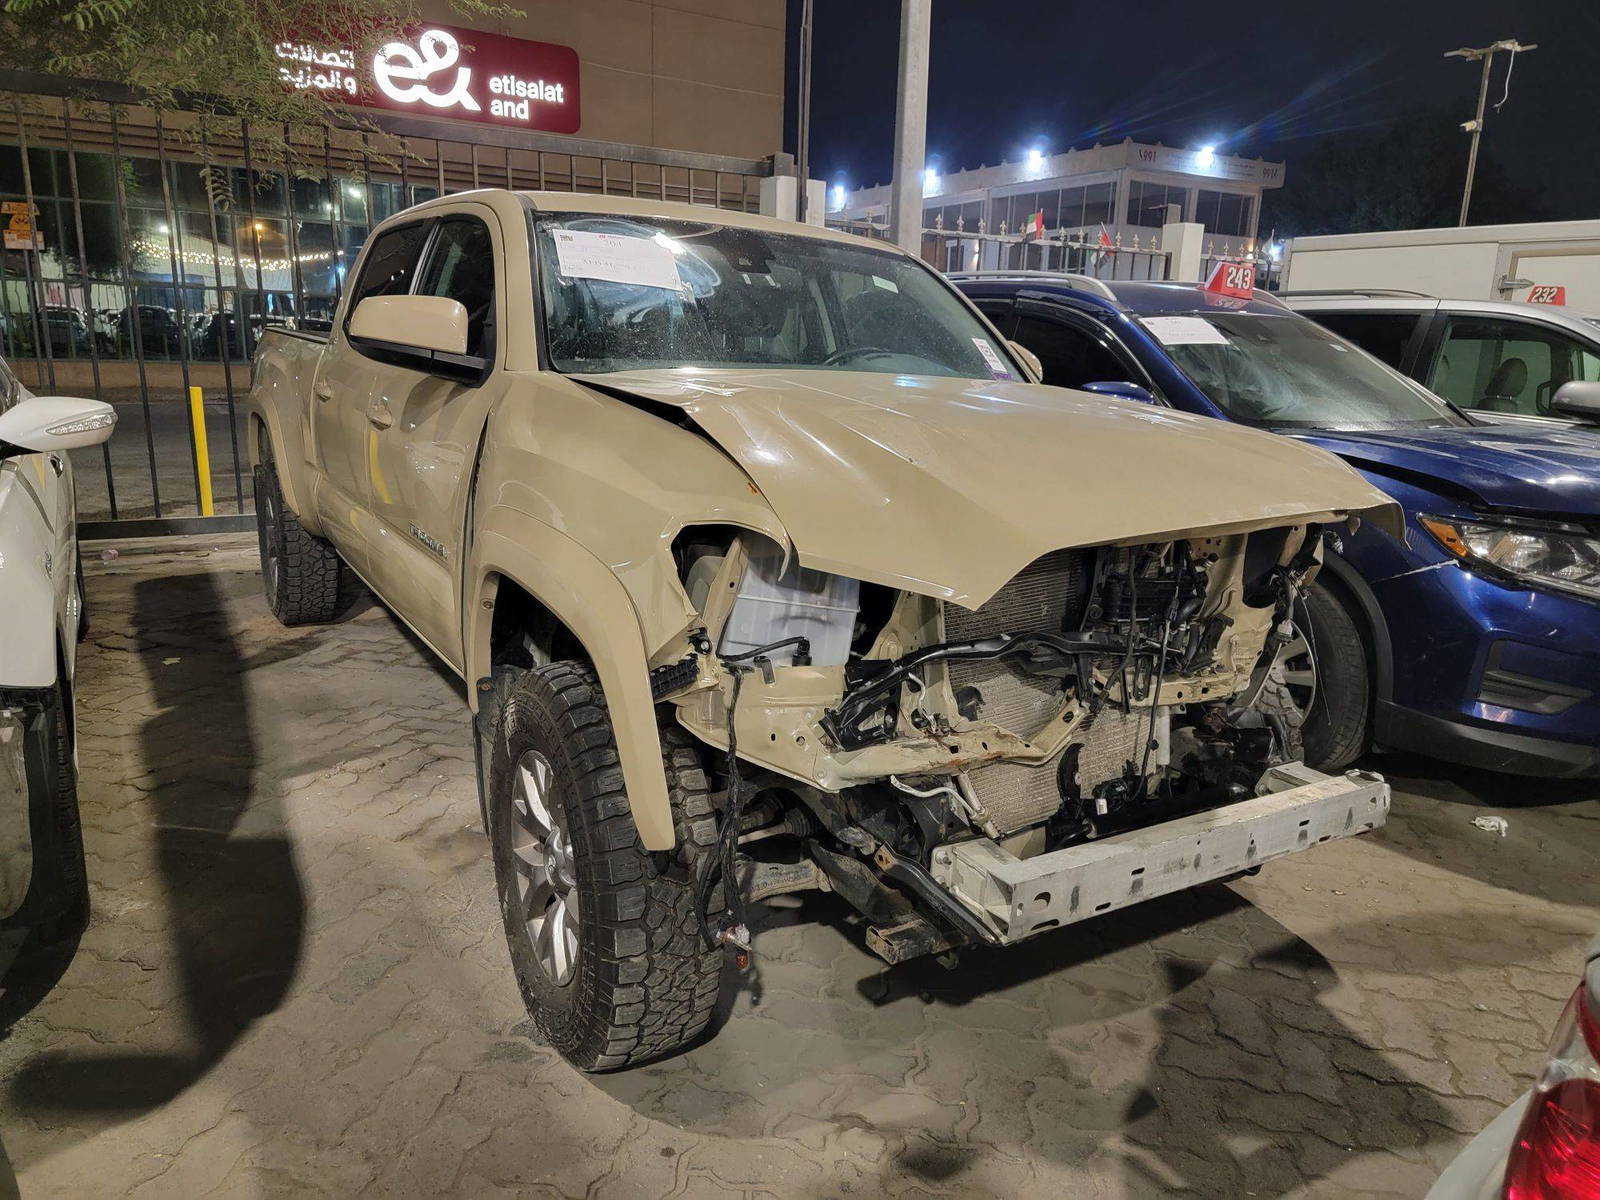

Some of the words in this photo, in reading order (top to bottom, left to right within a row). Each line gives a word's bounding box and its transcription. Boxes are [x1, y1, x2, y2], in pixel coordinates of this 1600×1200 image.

[489, 75, 564, 103] etisalat
[490, 98, 530, 120] and
[1225, 266, 1252, 290] 243
[1531, 287, 1558, 303] 232
